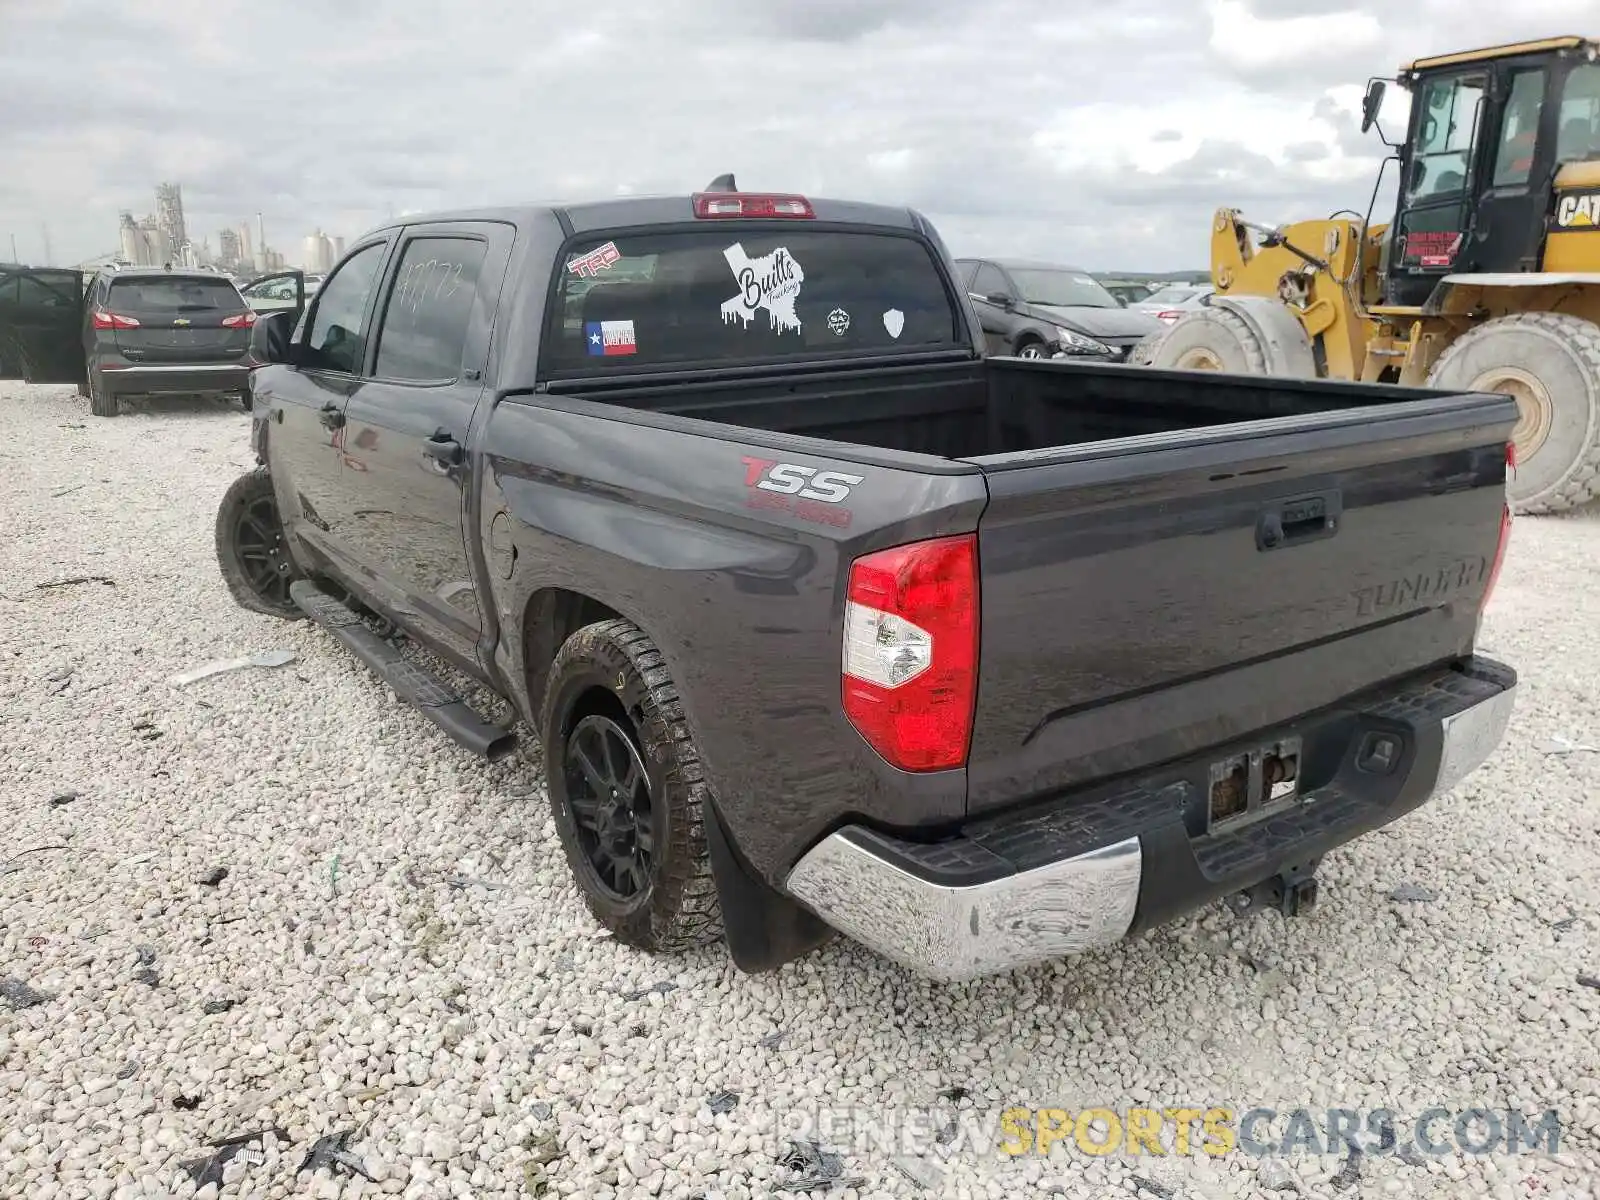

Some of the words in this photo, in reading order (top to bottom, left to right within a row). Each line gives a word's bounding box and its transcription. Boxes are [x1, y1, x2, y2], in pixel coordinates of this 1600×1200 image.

[1558, 195, 1600, 227] CAT
[570, 246, 620, 278] TRD
[738, 250, 794, 309] Builts
[741, 455, 865, 503] TSS
